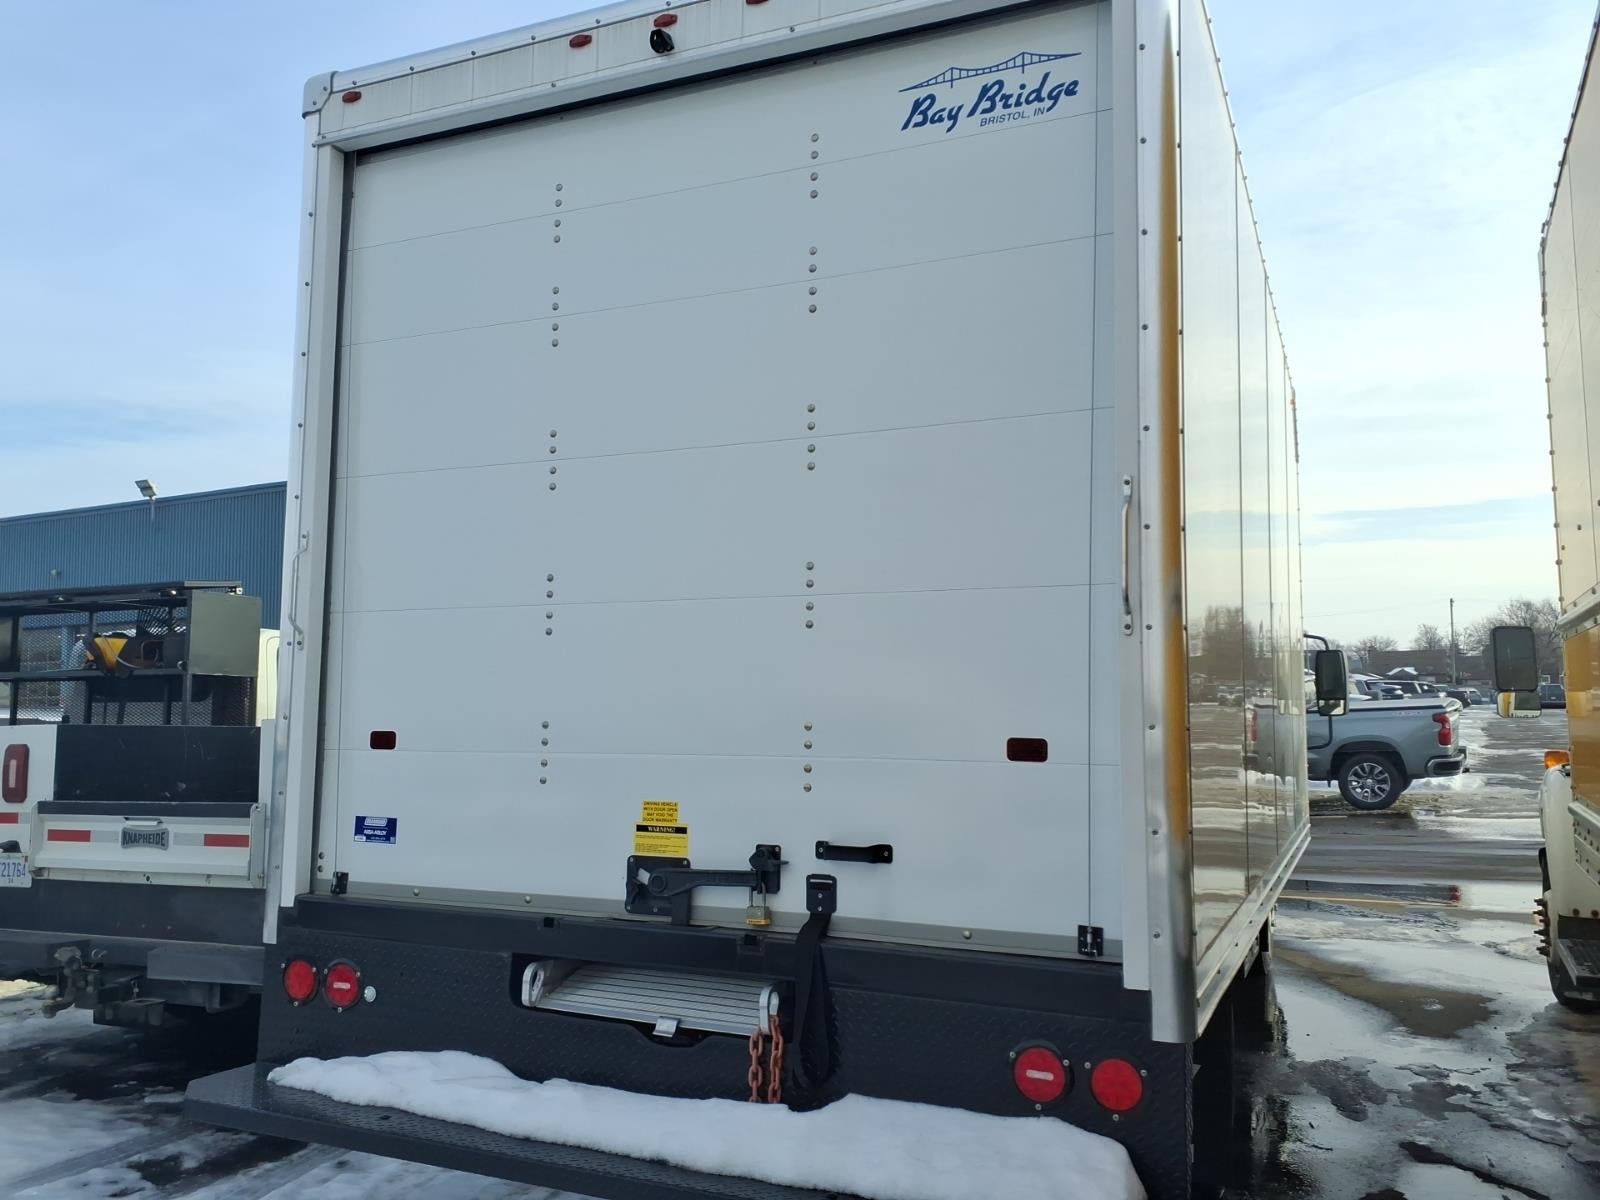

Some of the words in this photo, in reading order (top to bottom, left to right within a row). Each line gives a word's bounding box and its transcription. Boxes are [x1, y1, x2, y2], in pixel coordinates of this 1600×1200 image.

[901, 93, 964, 133] Bay
[967, 71, 1079, 118] Bridge
[980, 110, 1030, 127] BRISTOL,
[1033, 107, 1045, 116] IN
[122, 831, 166, 847] KNAPHEIDE
